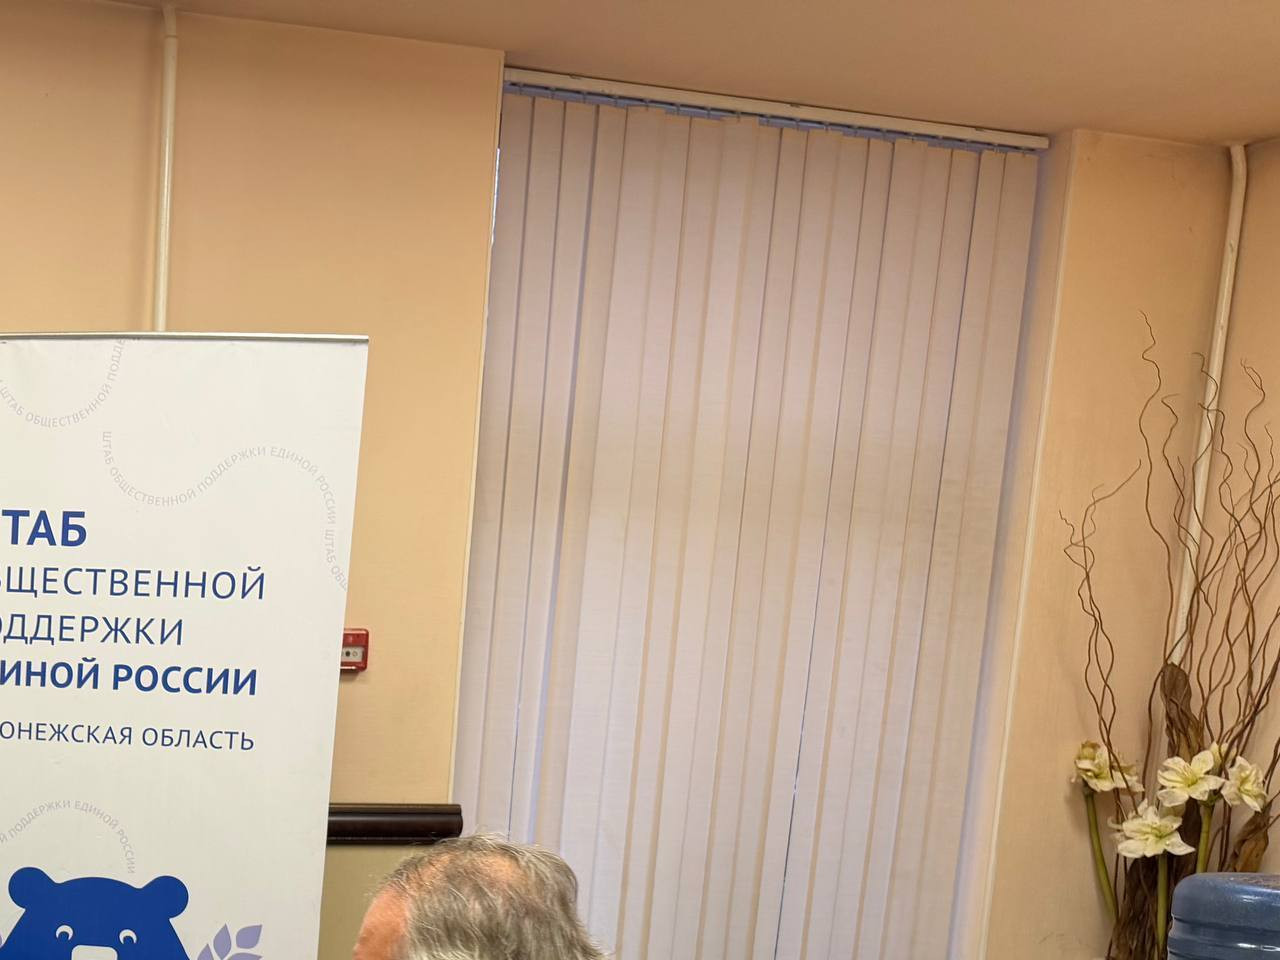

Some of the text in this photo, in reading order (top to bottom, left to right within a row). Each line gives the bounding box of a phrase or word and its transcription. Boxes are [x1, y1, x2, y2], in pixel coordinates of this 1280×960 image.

[0, 385, 24, 416] ШТАБ
[25, 383, 113, 428] ОБЩЕСТВЕННОЙ
[102, 431, 114, 465] ШТАБ
[270, 446, 319, 475] ЕДИНОЙ
[109, 467, 197, 507] ОБЩЕСТВЕННОЙ
[197, 446, 266, 494] ПОДДЕРЖКИ
[316, 475, 336, 525] РОССИИ
[324, 528, 336, 564] ШТАБ
[112, 663, 257, 696] РОССИИ
[141, 727, 255, 751] ОБЛАСТЬ
[8, 800, 71, 839] ПОДДЕРЖКИ
[74, 800, 120, 830] ЕДИНОЙ
[116, 829, 137, 874] РОССИИ
